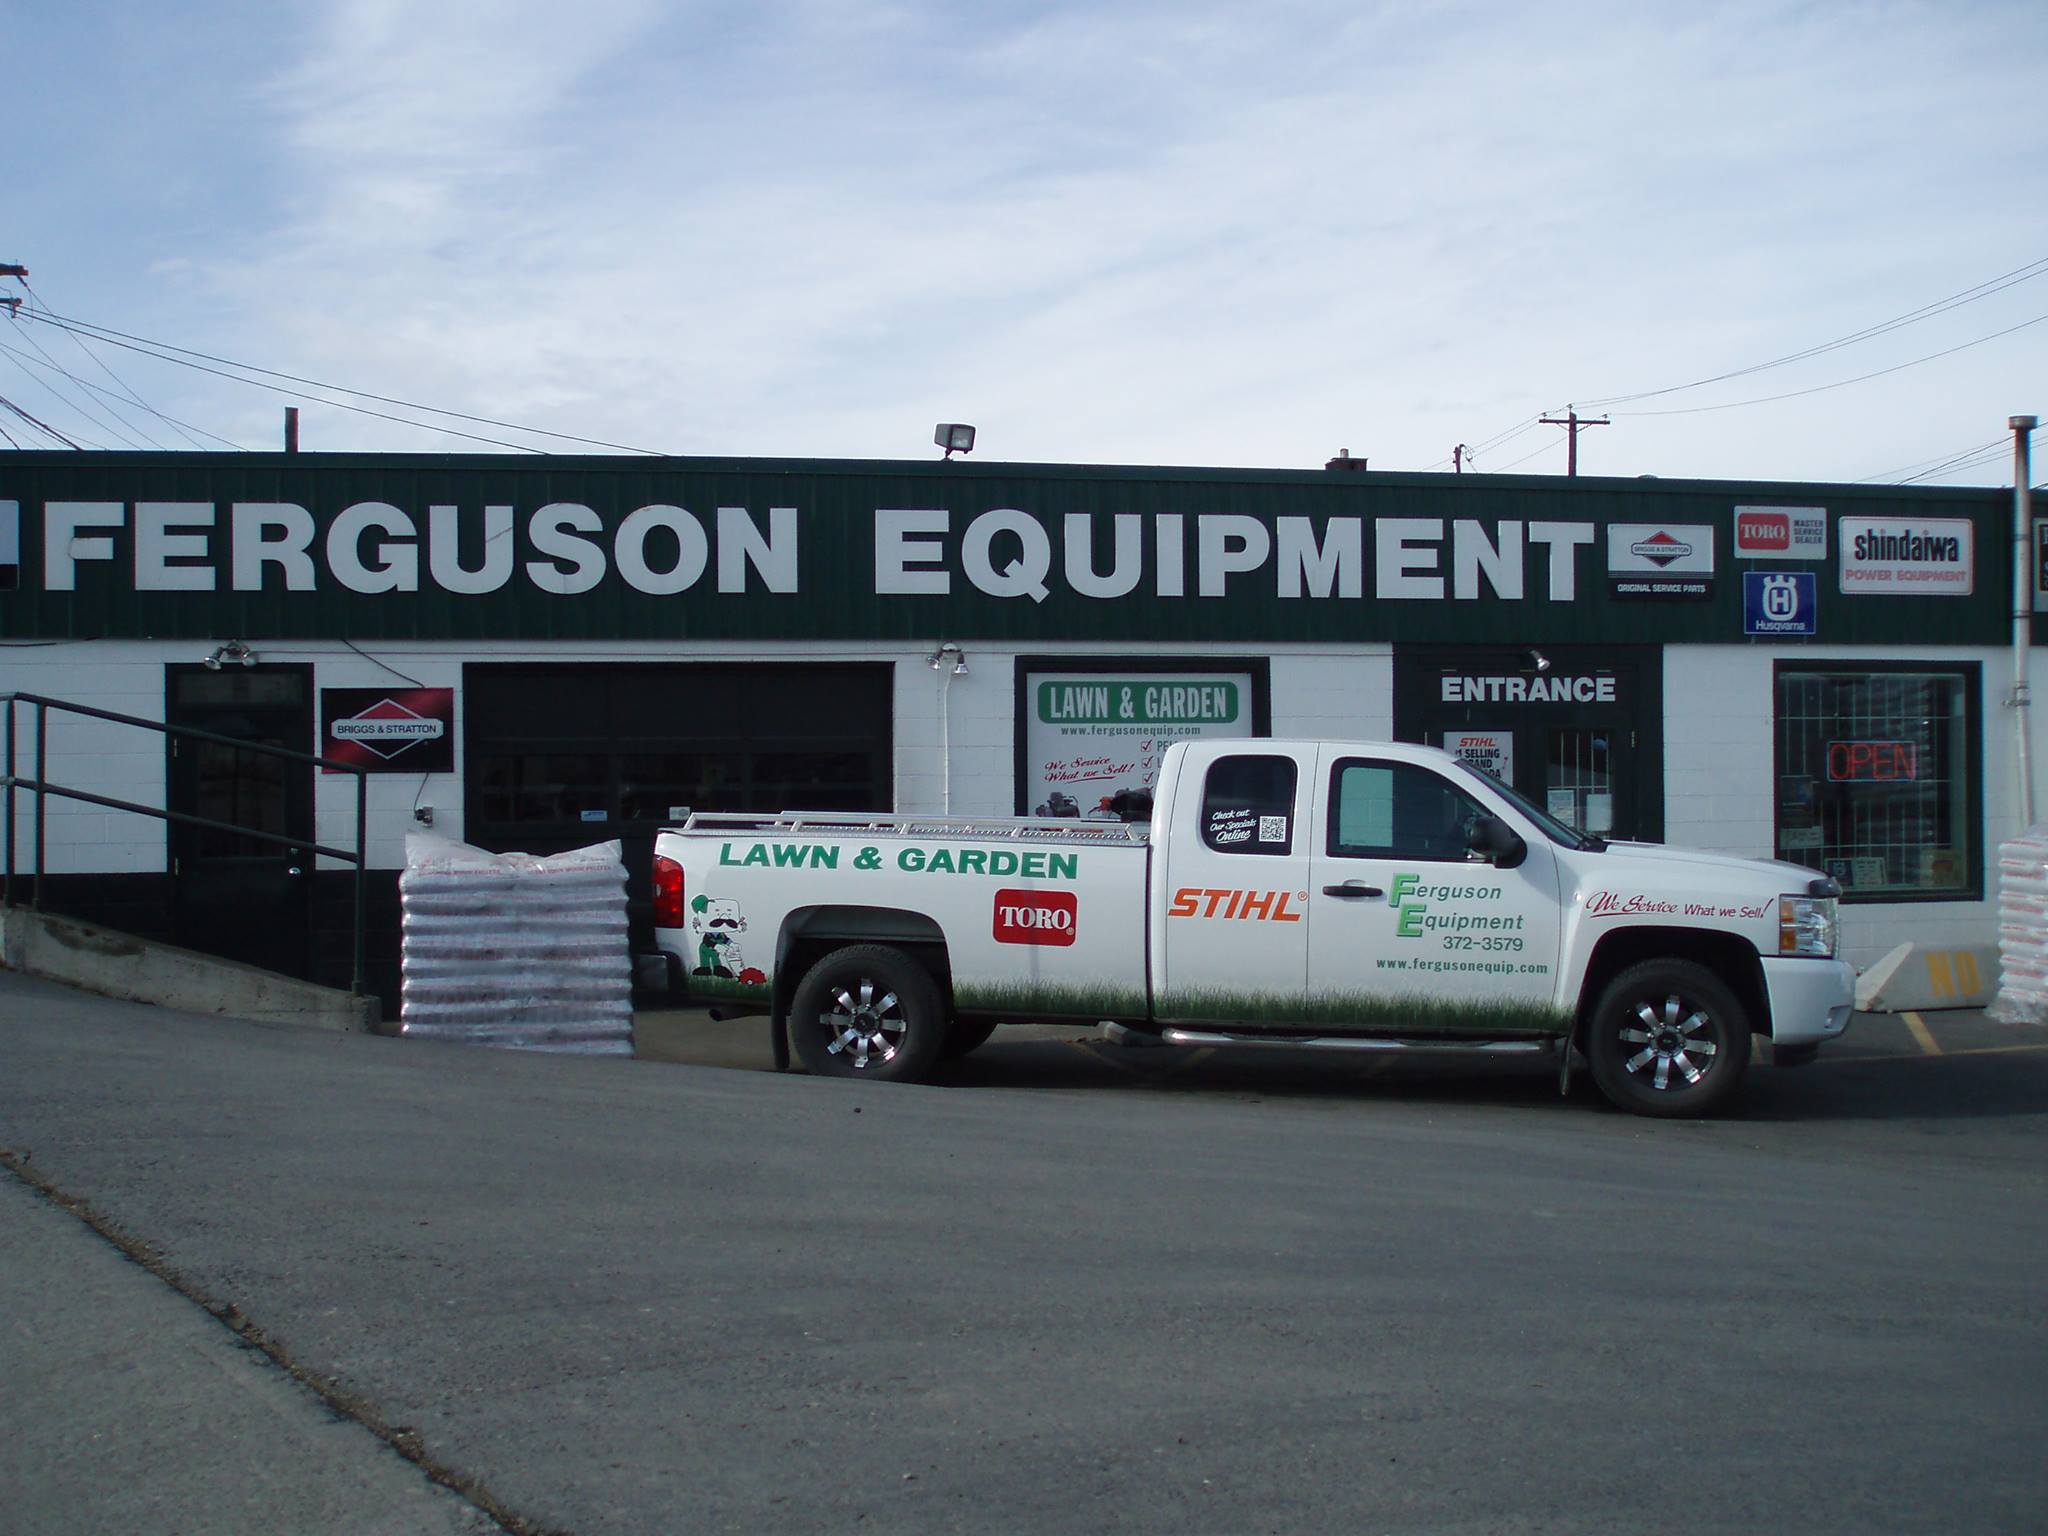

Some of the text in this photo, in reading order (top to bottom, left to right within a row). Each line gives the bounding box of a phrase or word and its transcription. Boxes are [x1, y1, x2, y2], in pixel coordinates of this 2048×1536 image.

[1741, 524, 1786, 539] TORO
[1795, 536, 1824, 544] DEALER
[43, 501, 1595, 604] FERGUSON EQUIPMENT
[1855, 528, 1959, 561] shindaiwa
[1845, 569, 1967, 582] POWER EQUIPMENT
[1617, 584, 1706, 593] ORIGINAL SERVICE PARTS
[1755, 620, 1806, 632] Husqvarna
[1441, 676, 1617, 703] ENTRANCE
[1050, 687, 1227, 719] LAWN & GARDEN
[337, 725, 437, 734] BRIGGS & STRATTON
[1061, 724, 1201, 737] www.fergusonequip.com
[1459, 737, 1496, 748] STIHL
[1465, 749, 1500, 758] SELLING
[1829, 743, 1916, 780] OPEN
[1045, 760, 1067, 771] We
[1045, 762, 1136, 782] What we Sell!
[1212, 809, 1251, 820] Check out
[1210, 819, 1257, 832] Our Specials
[1216, 829, 1251, 842] Online
[720, 843, 1078, 880] LAWN & GARDEN
[1389, 872, 1502, 907] Ferguson
[1168, 887, 1301, 922] STIHL
[1586, 891, 1774, 919] We Service What we Sell!
[1000, 906, 1072, 930] TORO
[1396, 903, 1524, 937] Equipment
[1443, 936, 1524, 952] 372-3579
[1376, 957, 1549, 975] www.fergusonequip.com
[1925, 951, 1984, 998] NO
